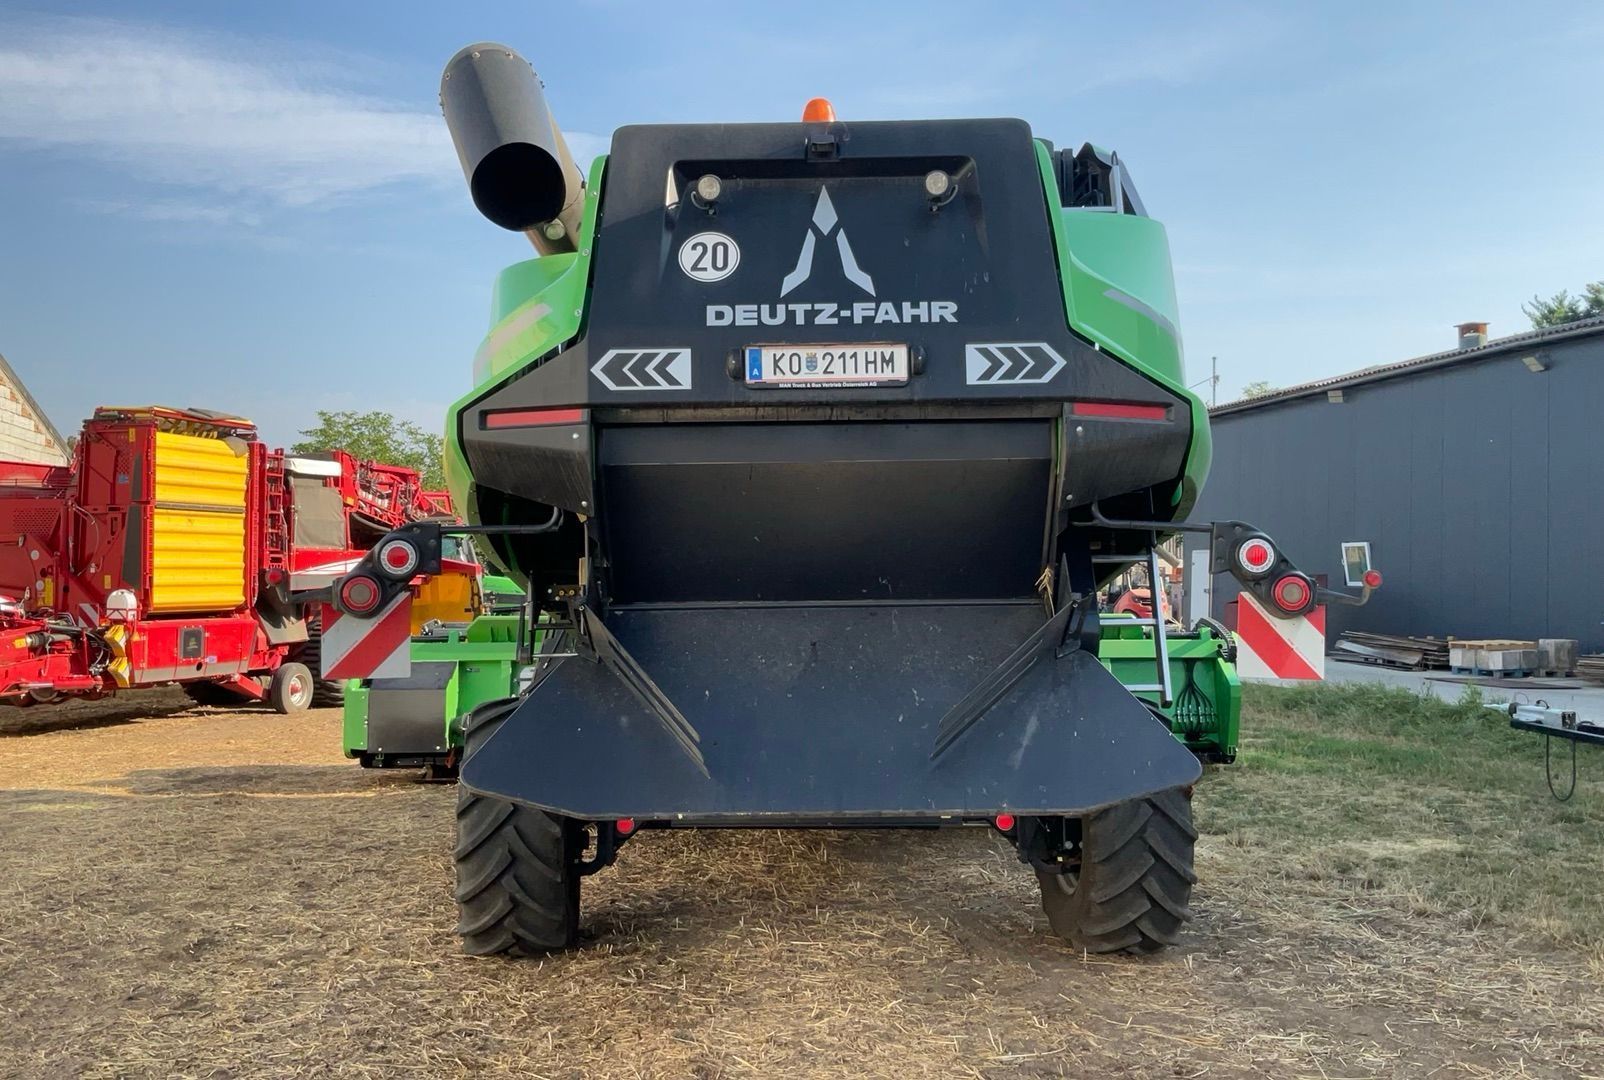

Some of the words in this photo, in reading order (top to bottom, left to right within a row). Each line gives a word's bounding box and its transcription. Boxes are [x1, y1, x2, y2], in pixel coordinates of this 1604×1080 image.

[690, 241, 729, 272] 20
[706, 301, 959, 327] DEUTZ-FAHR
[752, 368, 760, 377] A
[773, 352, 802, 376] KO
